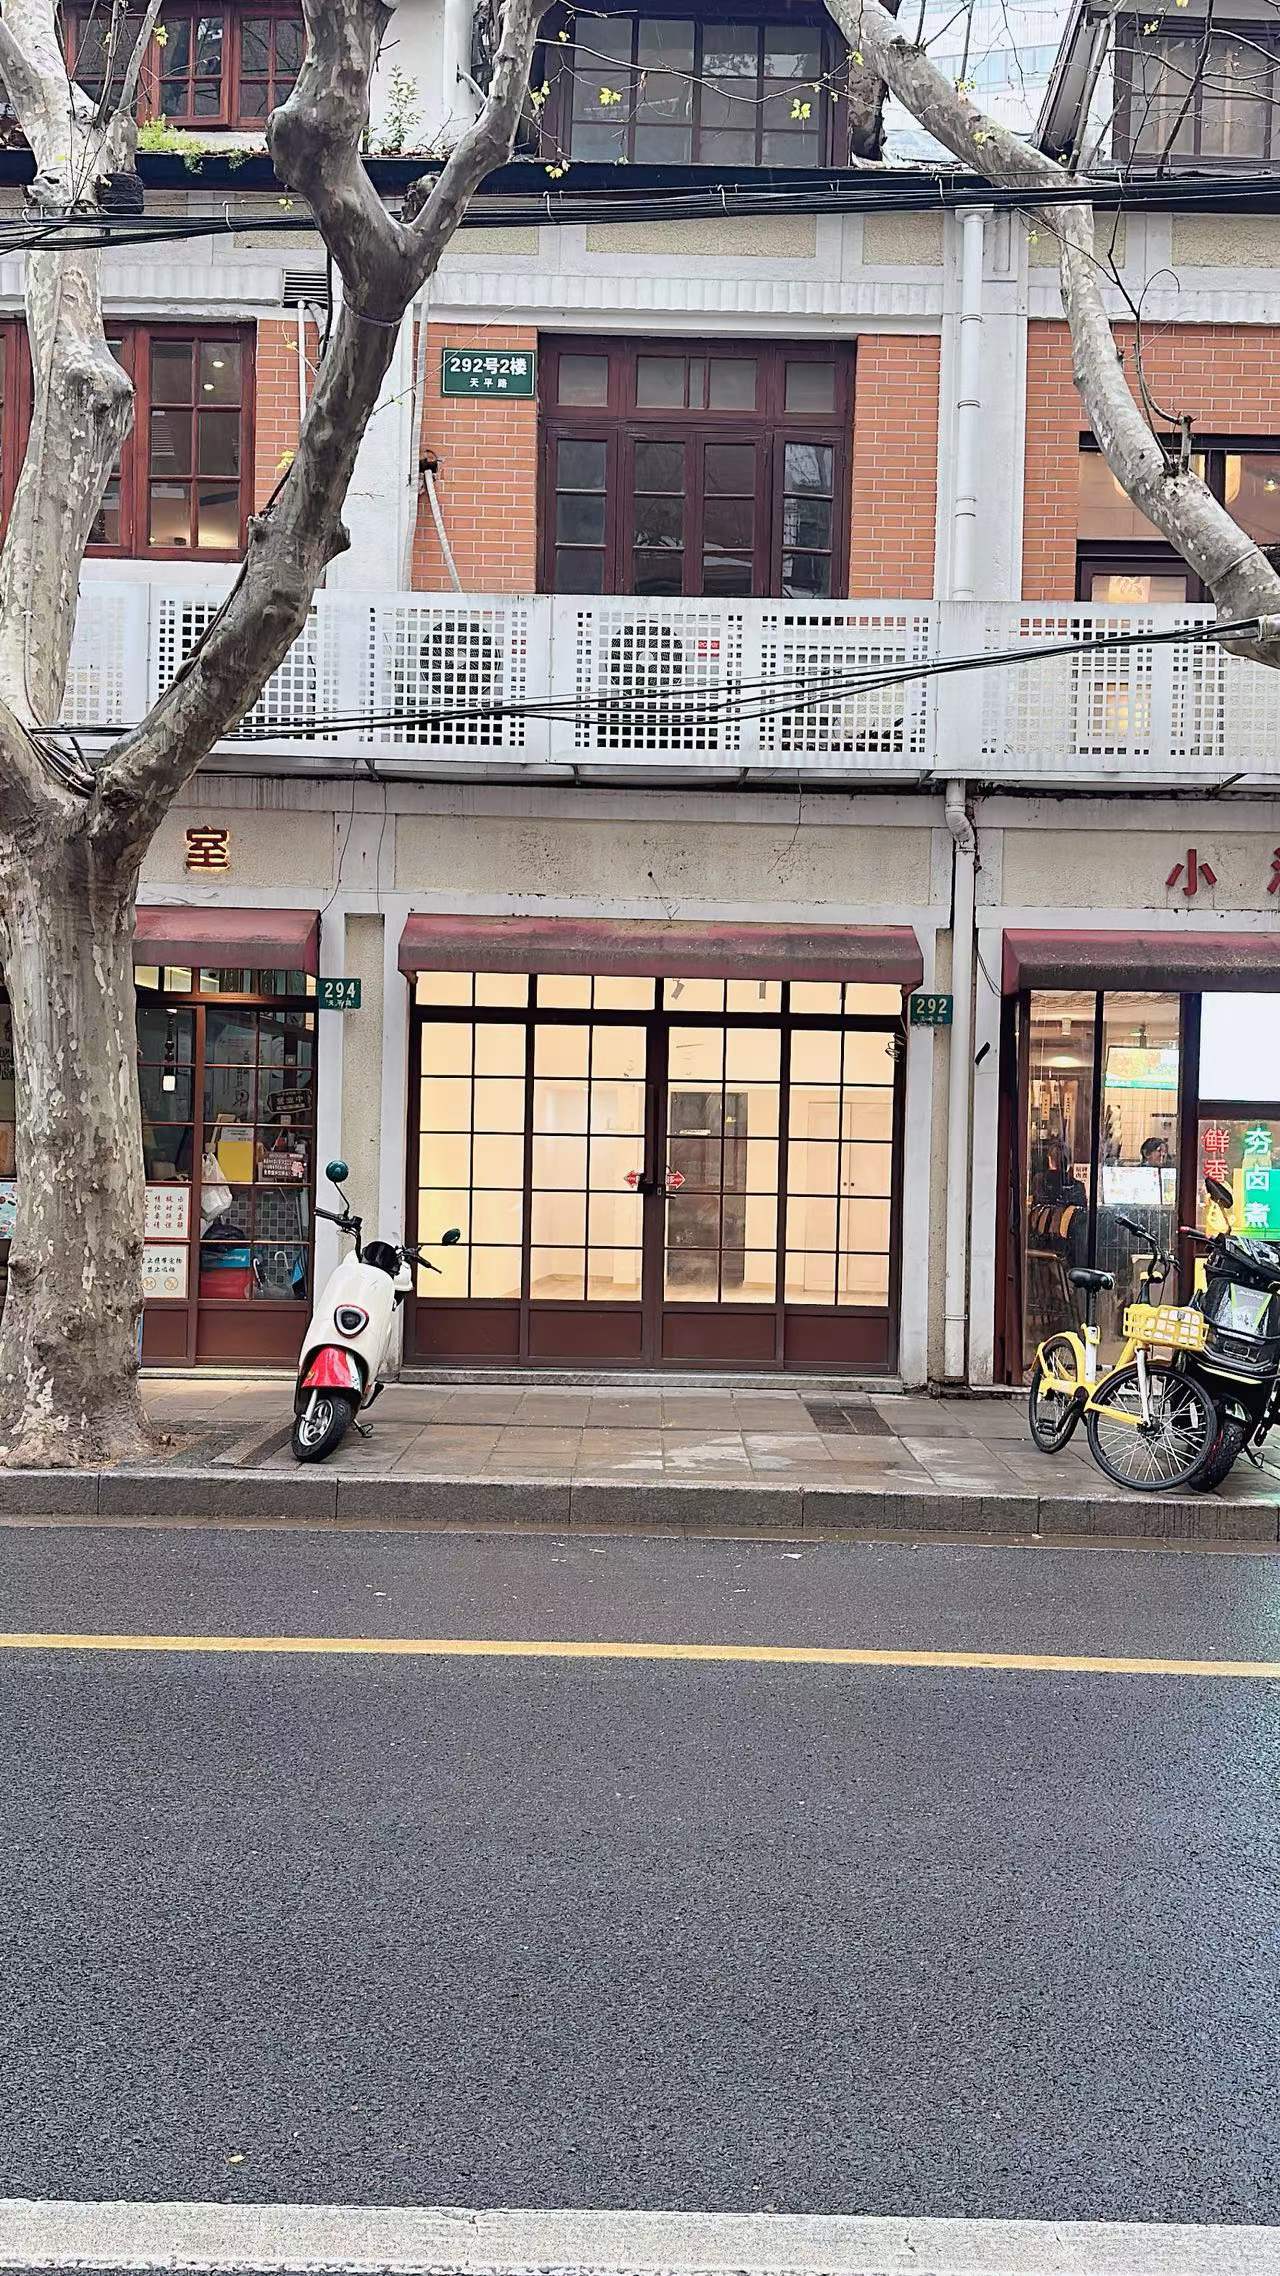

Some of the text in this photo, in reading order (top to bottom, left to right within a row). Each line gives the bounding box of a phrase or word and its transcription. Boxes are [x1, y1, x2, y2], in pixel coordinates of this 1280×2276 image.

[450, 357, 527, 375] 292号2楼
[469, 377, 508, 388] 天平路
[186, 825, 228, 868] 室
[324, 982, 356, 998] 294
[916, 998, 947, 1014] 292
[1244, 1126, 1273, 1229] 夯卤煮
